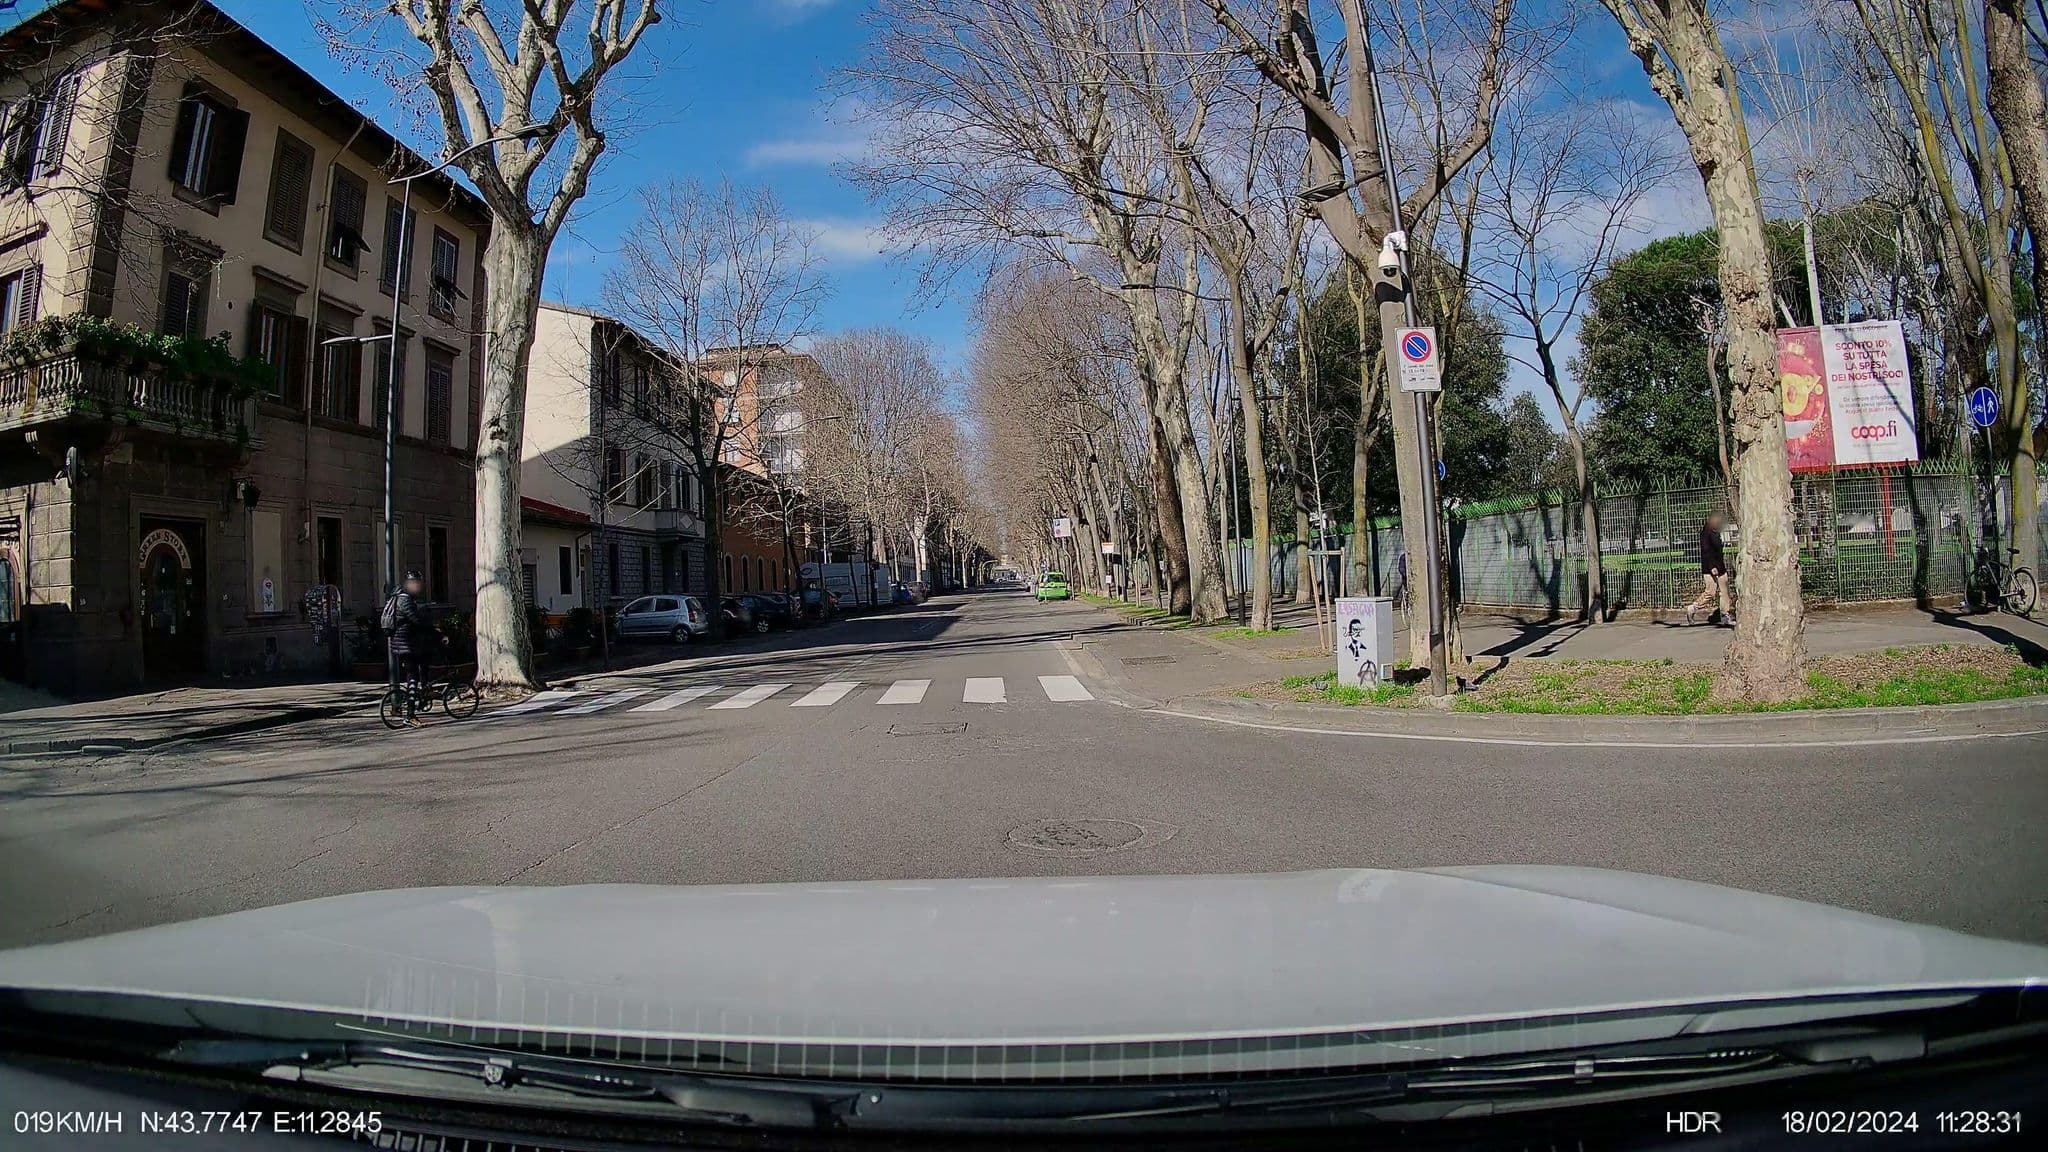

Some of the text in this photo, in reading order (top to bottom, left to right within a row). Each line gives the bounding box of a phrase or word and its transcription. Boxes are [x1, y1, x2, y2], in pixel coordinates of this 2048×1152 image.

[1835, 340, 1873, 350] SCONTO
[1843, 350, 1887, 360] SU TUTTA
[1845, 360, 1888, 370] LA SPESA
[1832, 370, 1904, 382] DEI NOSTRI SOCI
[1851, 420, 1897, 441] coop.fi
[164, 531, 187, 561] STORE
